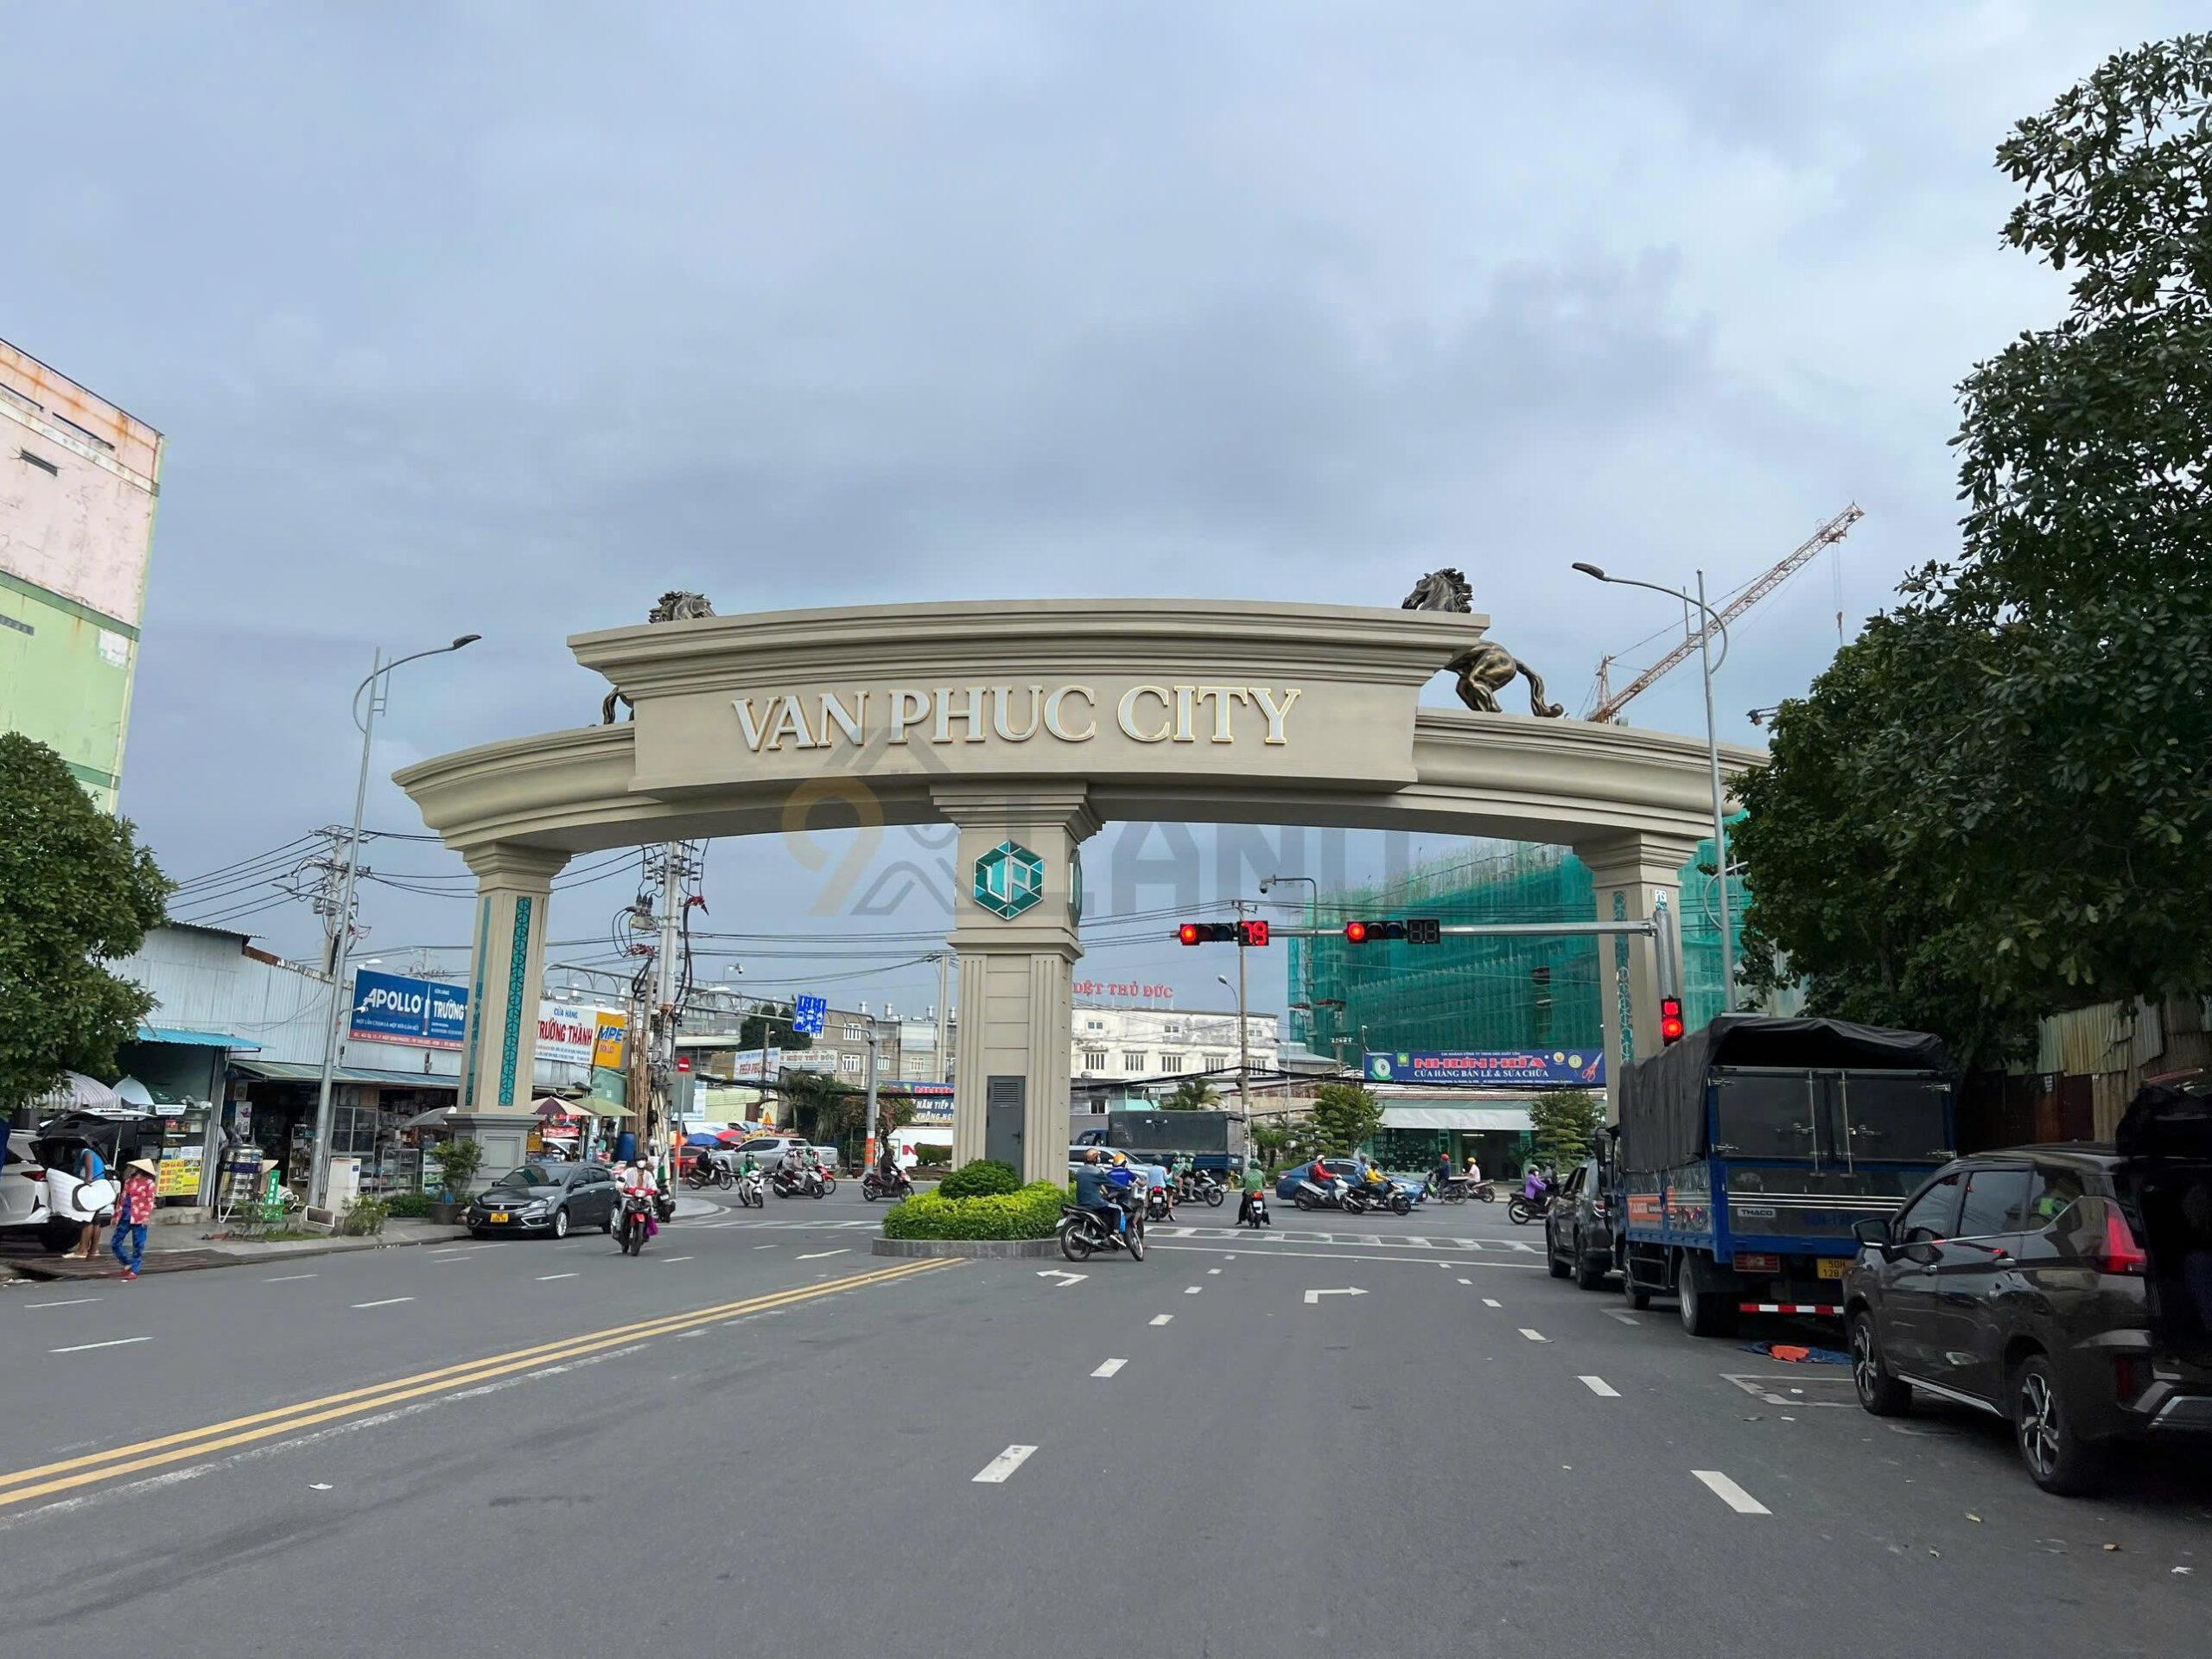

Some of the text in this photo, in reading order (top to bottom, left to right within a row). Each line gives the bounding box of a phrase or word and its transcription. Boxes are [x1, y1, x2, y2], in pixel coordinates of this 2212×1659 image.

[731, 684, 1302, 752] VAN PHUC CITY
[363, 988, 422, 1014] APOLLO
[1414, 1068, 1433, 1077] CỬA
[1436, 1068, 1459, 1077] HÀNG
[1522, 1068, 1549, 1077] CHỮA
